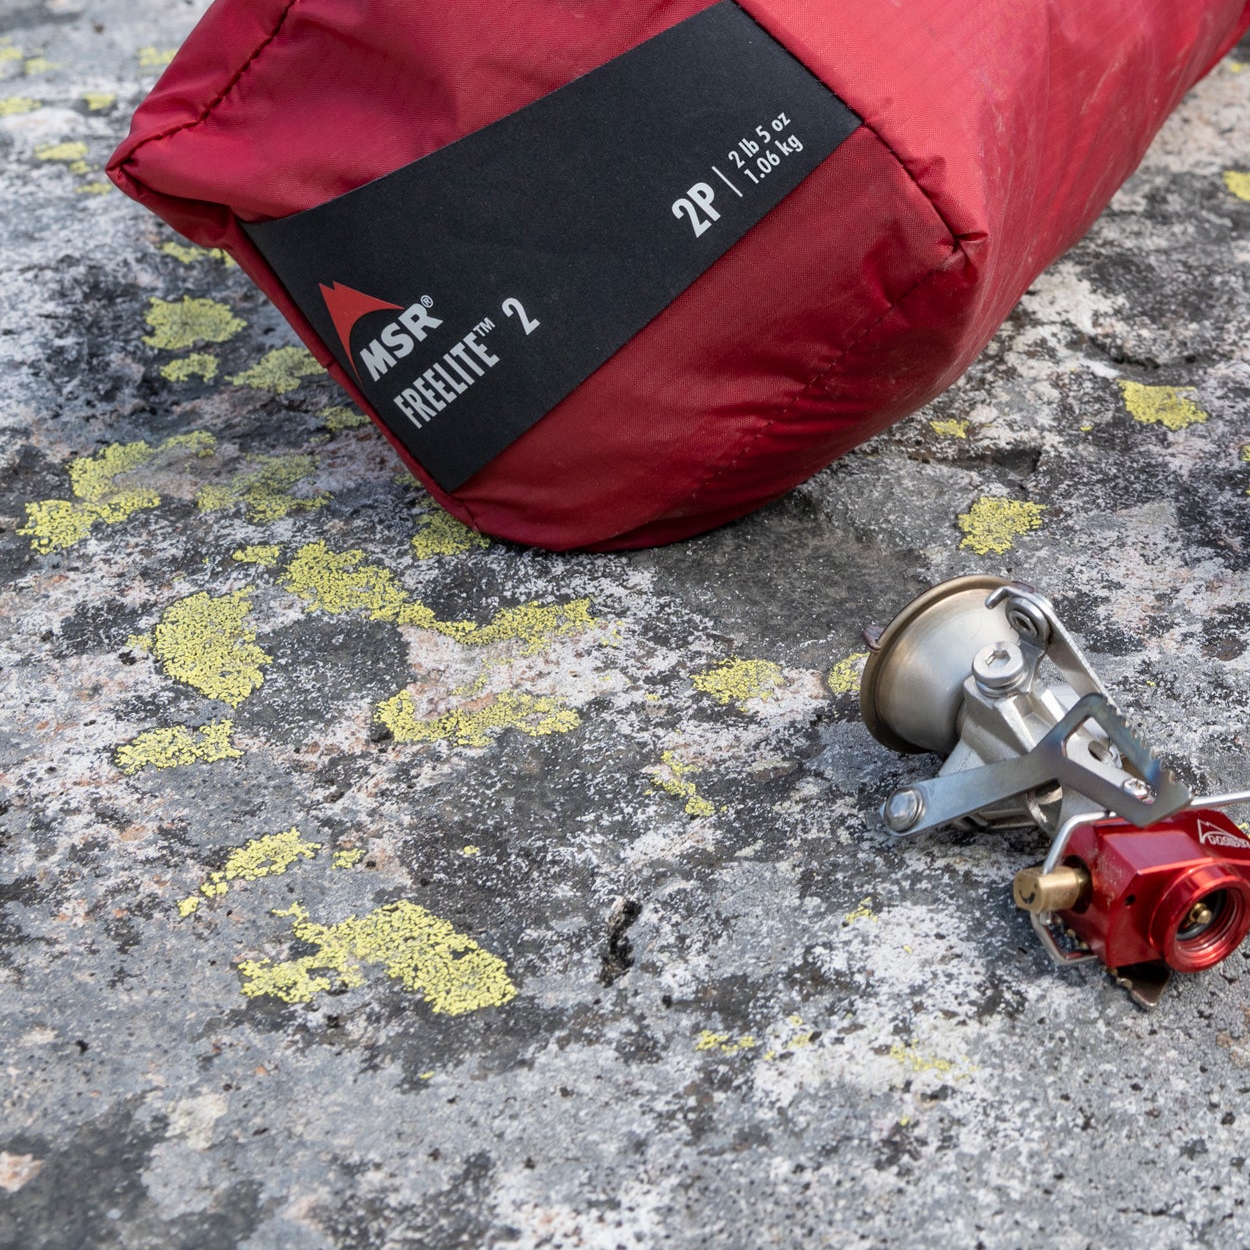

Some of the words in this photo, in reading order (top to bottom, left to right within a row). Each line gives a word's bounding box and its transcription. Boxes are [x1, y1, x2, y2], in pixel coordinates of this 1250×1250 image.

[728, 150, 746, 169] 2
[738, 137, 760, 158] lb
[755, 125, 771, 144] 5
[771, 112, 791, 132] oz
[743, 150, 781, 184] 1.06
[774, 134, 804, 156] kg
[671, 182, 721, 238] 2P
[501, 297, 541, 336] 2
